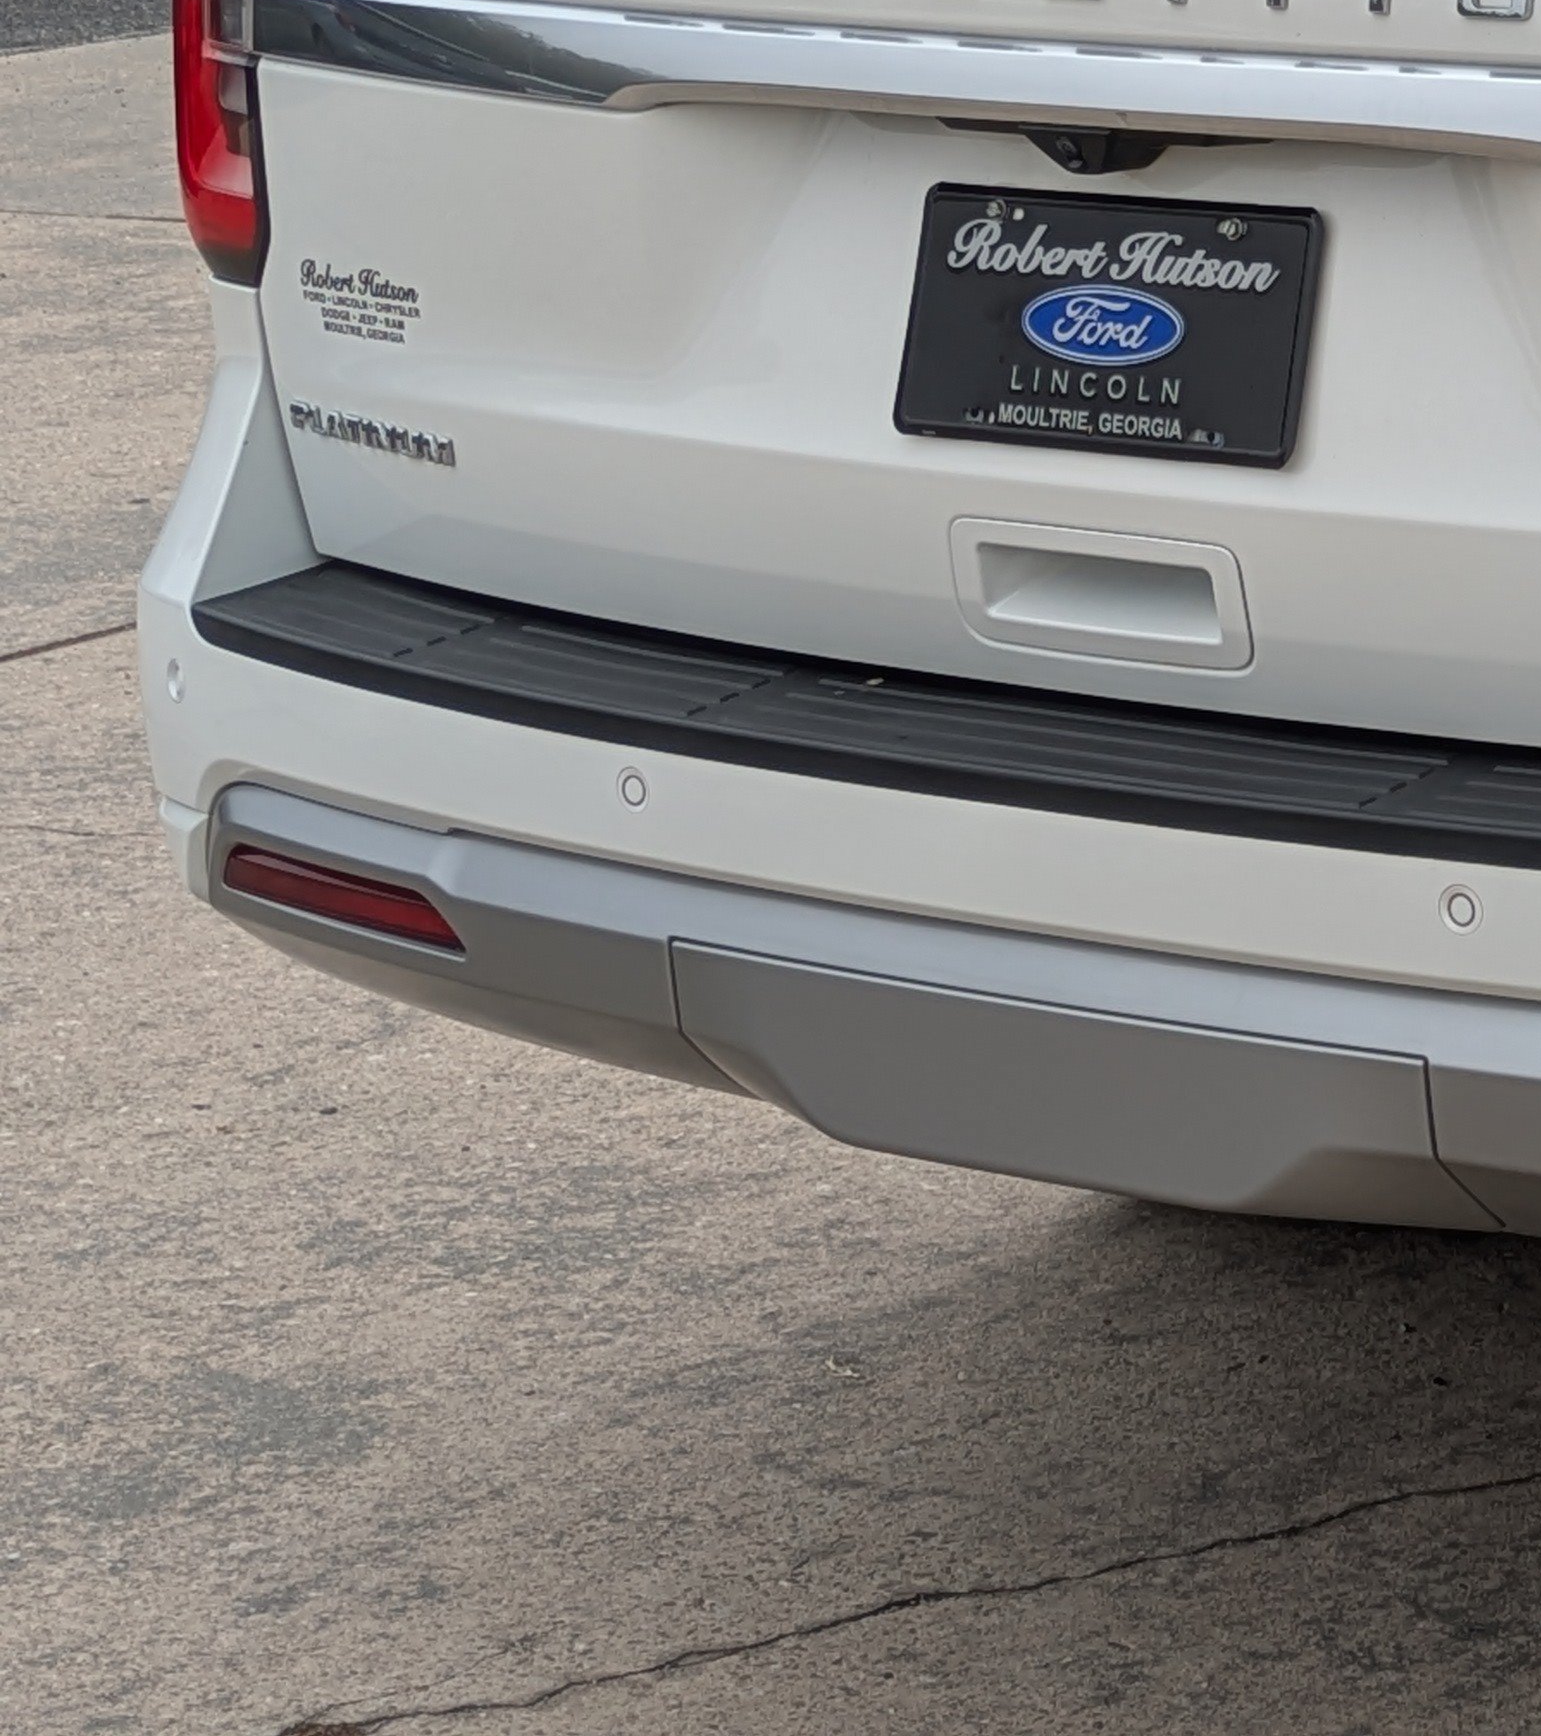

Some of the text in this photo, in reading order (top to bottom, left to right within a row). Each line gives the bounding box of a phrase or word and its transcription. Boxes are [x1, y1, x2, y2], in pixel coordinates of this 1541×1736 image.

[946, 217, 1281, 293] Robert Hutson
[299, 257, 419, 304] Robert Hutson
[1052, 295, 1154, 350] Ford
[1009, 364, 1182, 405] LINCOLN
[998, 402, 1183, 441] MOULTRIE, GEORGIA
